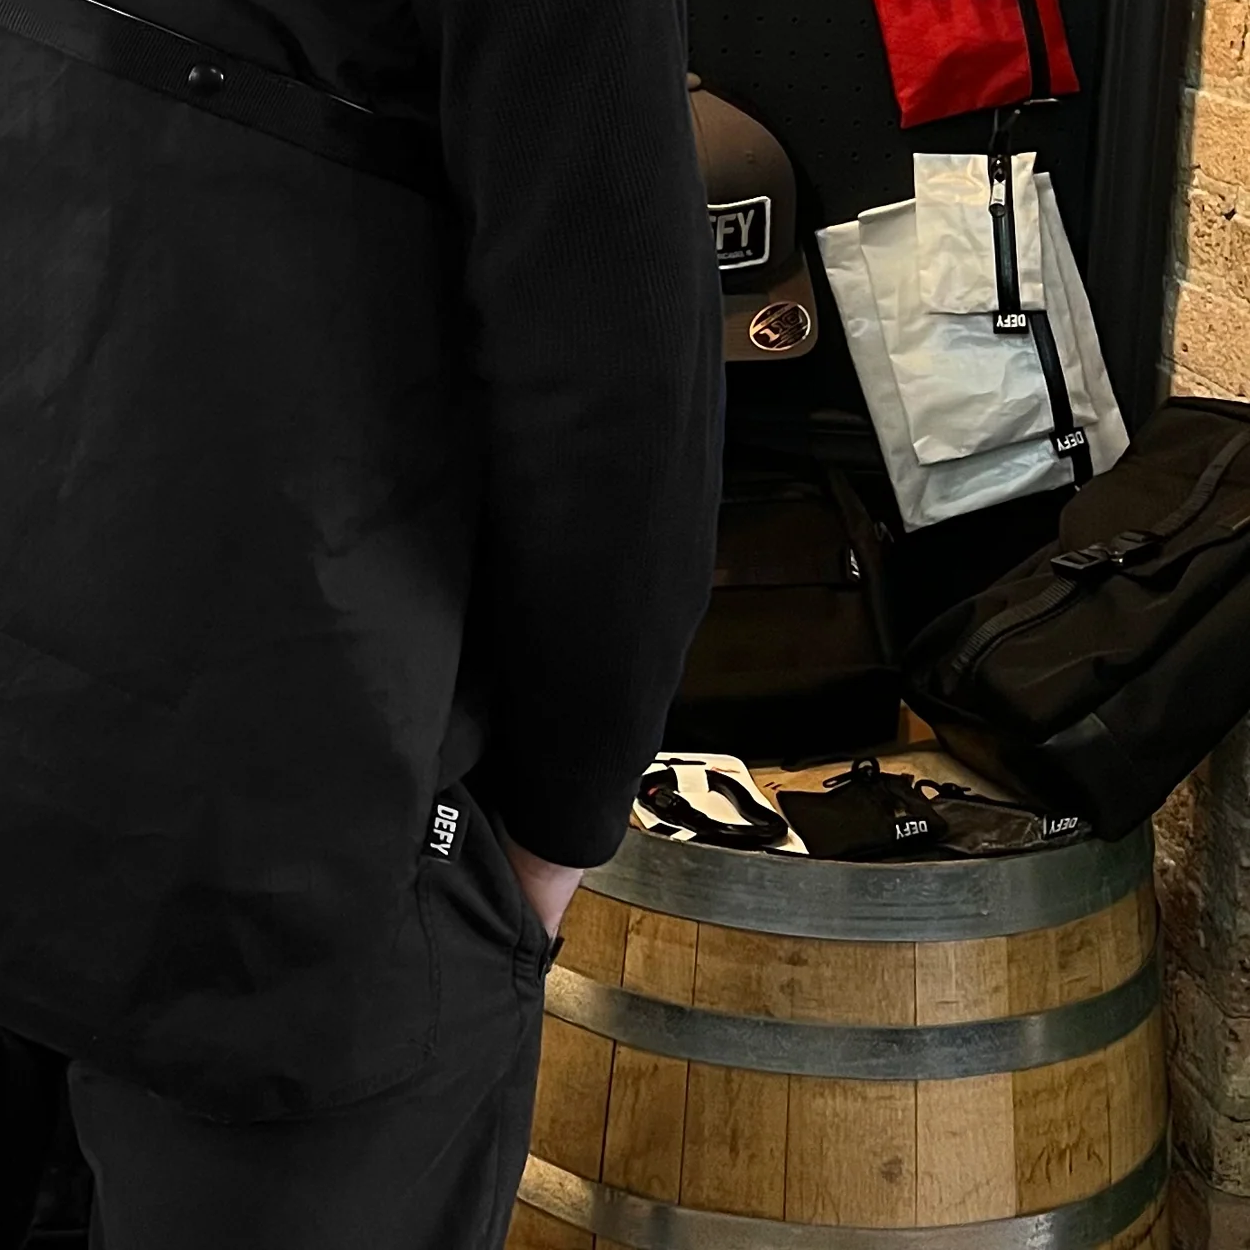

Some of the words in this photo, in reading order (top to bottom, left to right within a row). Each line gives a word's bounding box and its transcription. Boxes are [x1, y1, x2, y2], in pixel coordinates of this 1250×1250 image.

[996, 313, 1026, 328] DEFY
[1056, 431, 1084, 451] DEFY
[430, 804, 459, 856] DEFY
[895, 820, 928, 840] DEFY
[1049, 816, 1078, 835] DEFY
